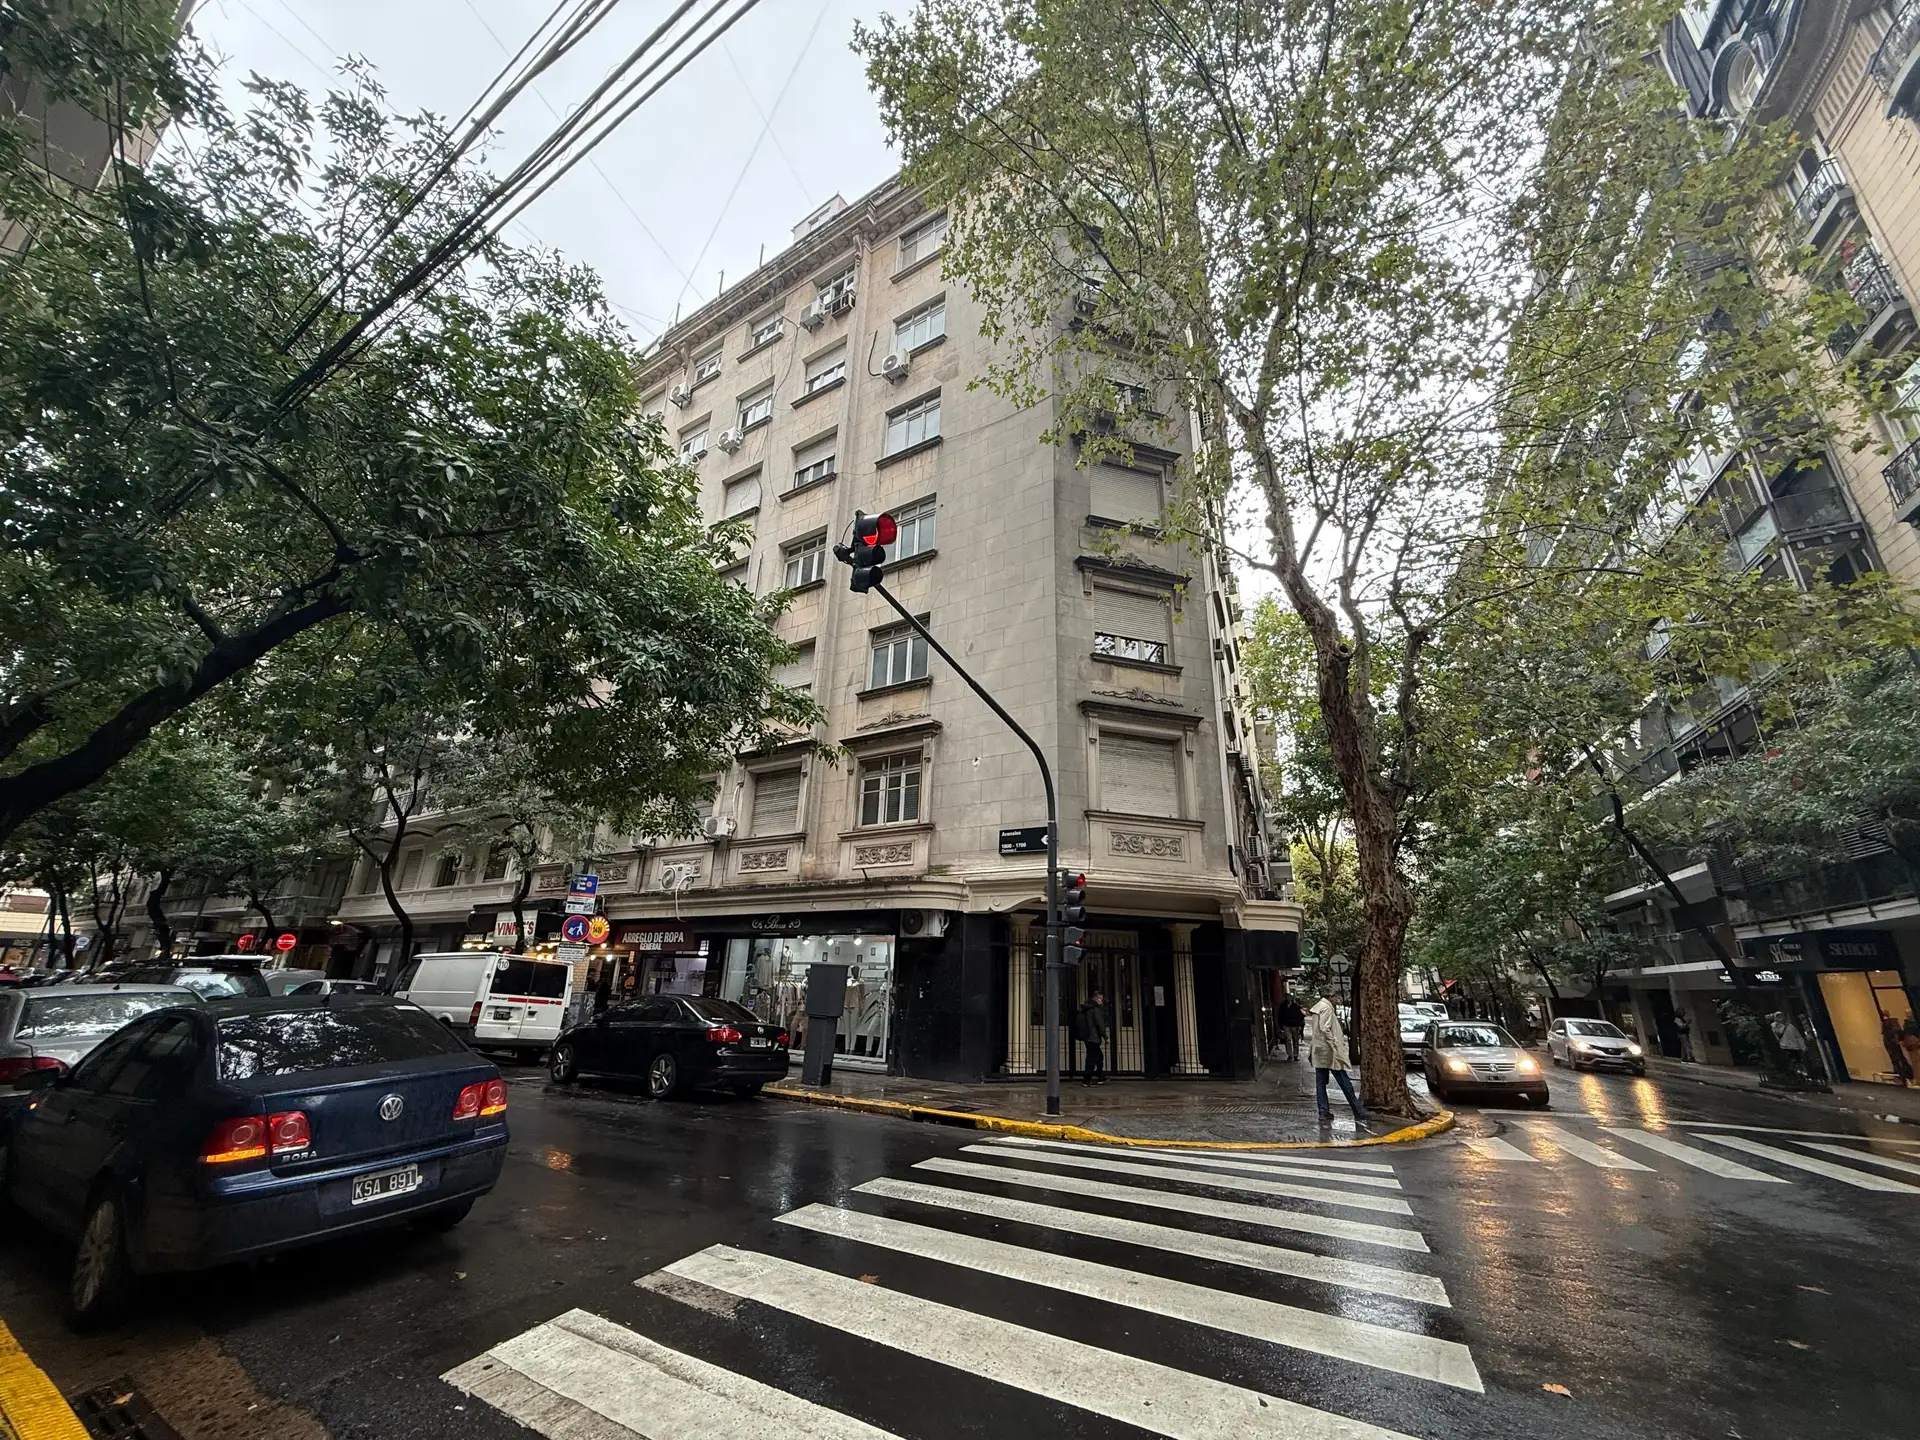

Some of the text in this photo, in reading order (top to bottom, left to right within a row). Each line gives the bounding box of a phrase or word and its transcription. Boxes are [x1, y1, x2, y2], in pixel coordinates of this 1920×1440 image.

[621, 931, 685, 943] ARREGLO DE ROPA
[639, 942, 663, 951] GENERAL
[282, 1150, 318, 1162] BORA
[354, 1171, 415, 1199] KSA 891
